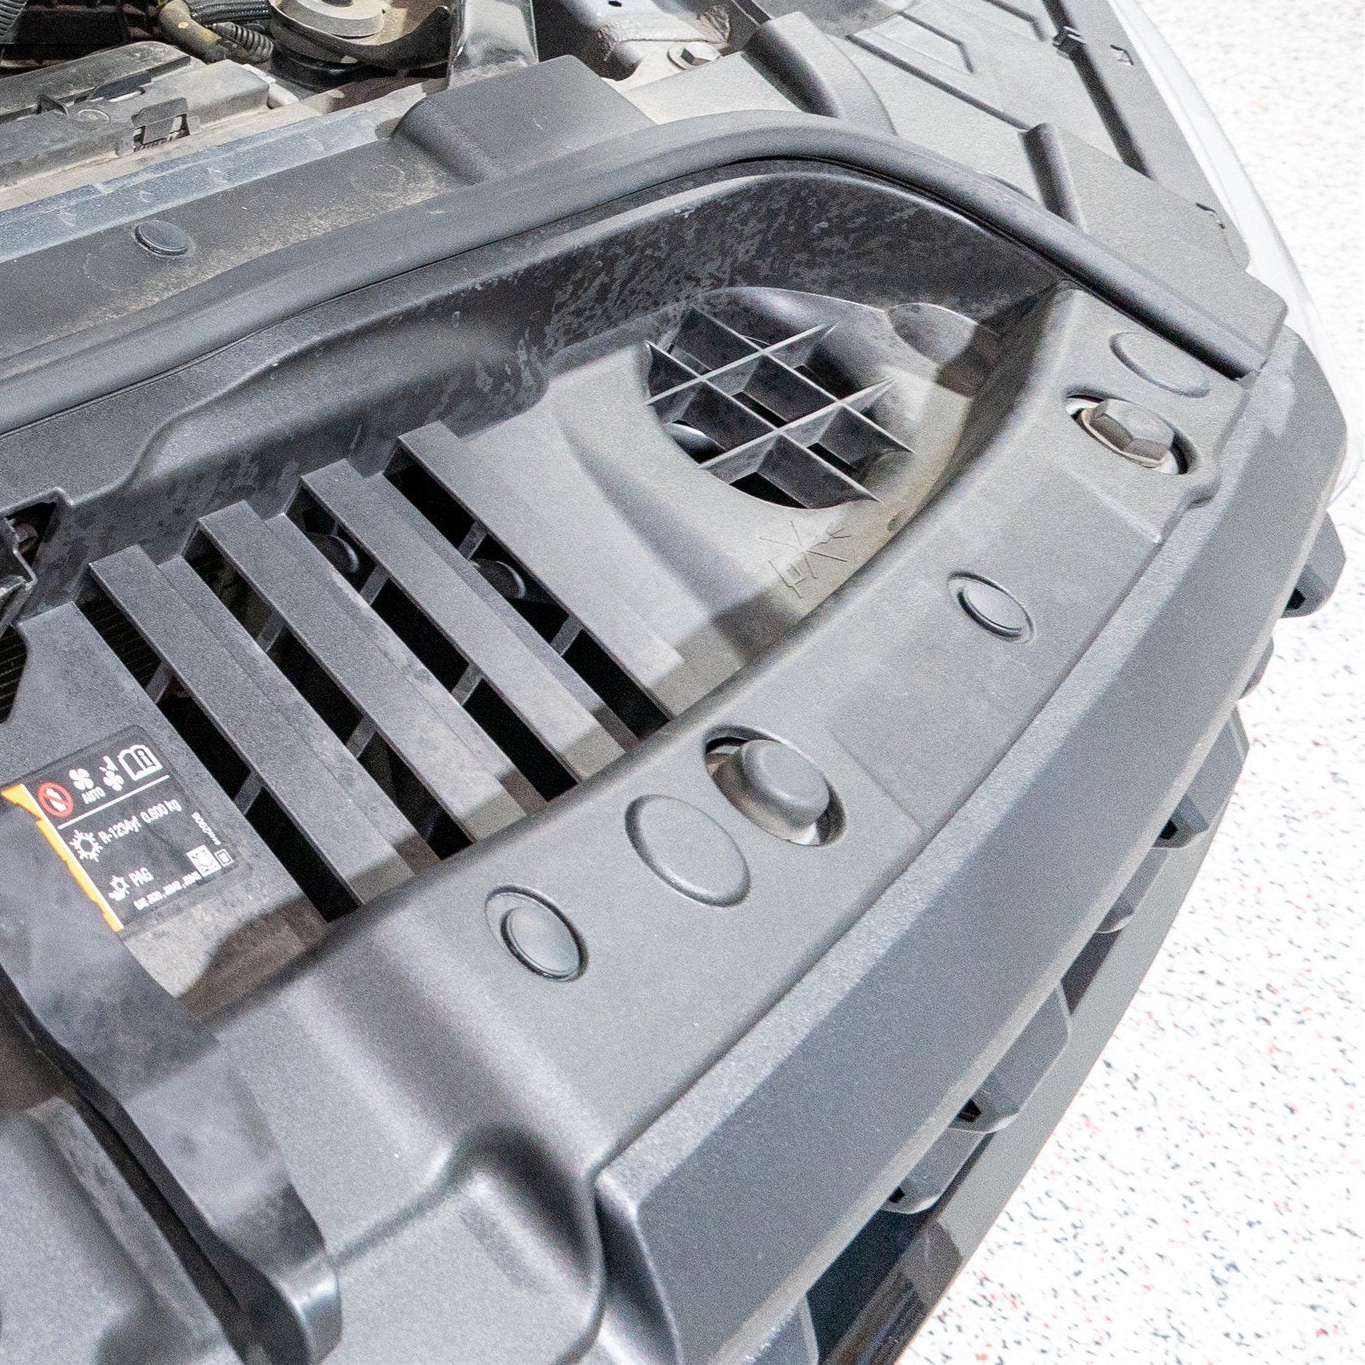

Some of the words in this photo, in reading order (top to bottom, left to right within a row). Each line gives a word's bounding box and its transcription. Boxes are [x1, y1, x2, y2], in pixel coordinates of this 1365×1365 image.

[81, 786, 106, 804] AUTO
[97, 816, 142, 845] R-1234yf
[164, 799, 183, 812] kg
[128, 867, 154, 887] PAG
